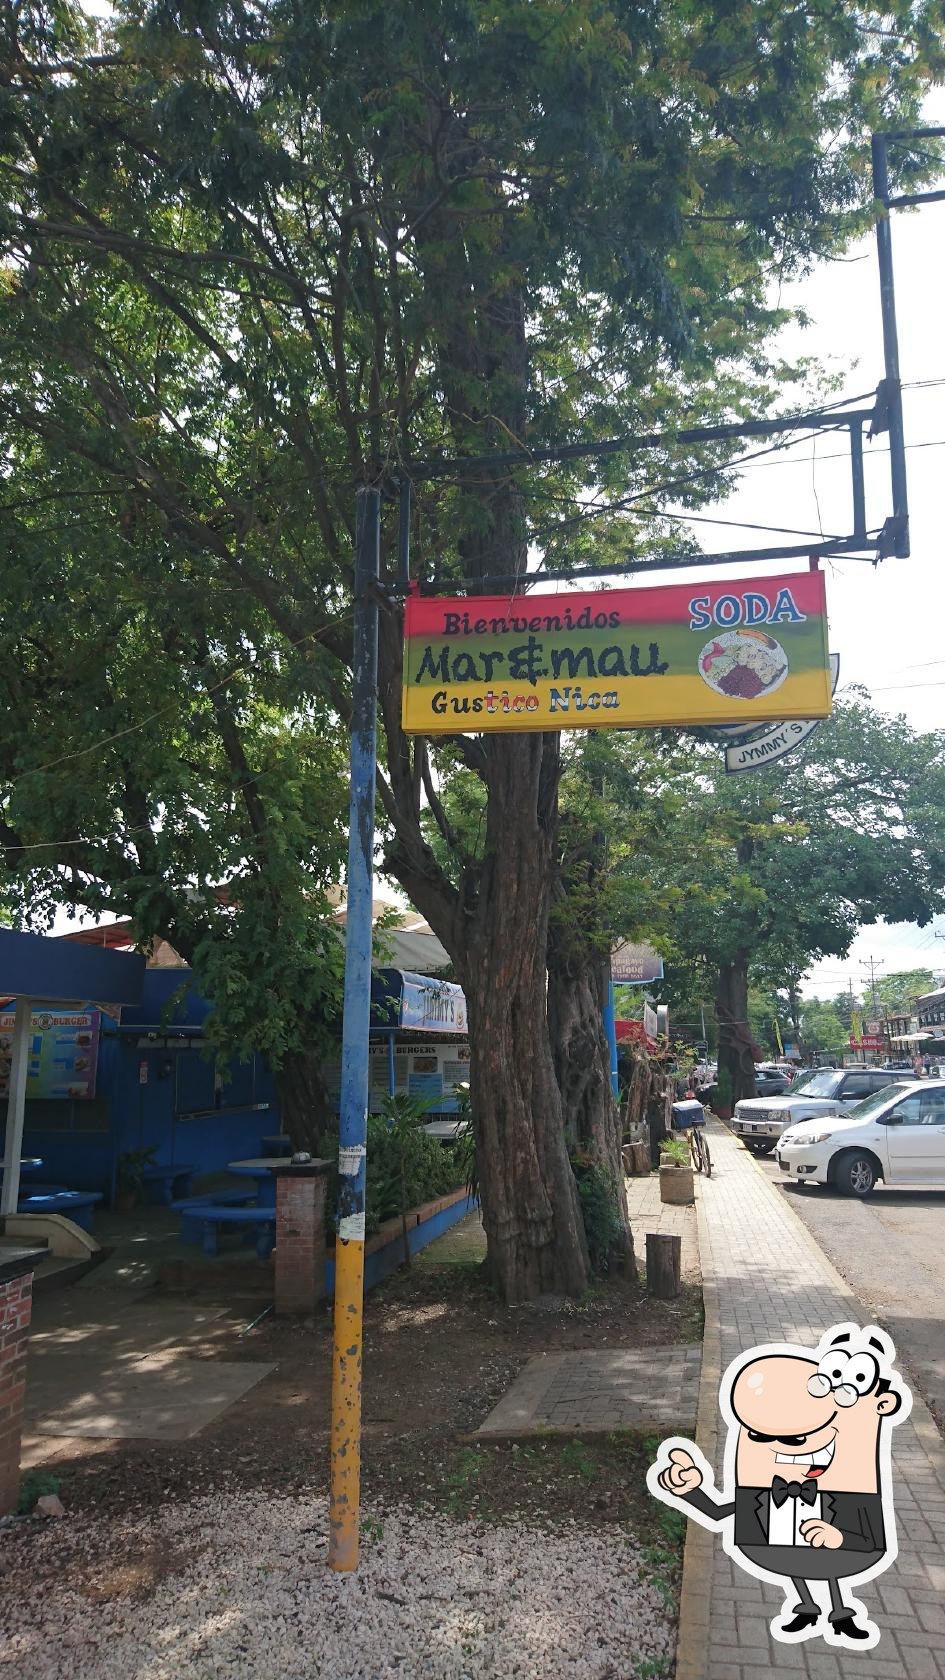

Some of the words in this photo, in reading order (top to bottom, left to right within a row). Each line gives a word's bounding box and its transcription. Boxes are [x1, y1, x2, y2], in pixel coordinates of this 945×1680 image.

[442, 606, 620, 635] Bienvenidos
[688, 587, 807, 631] SODA
[431, 690, 540, 714] Gustico
[549, 686, 620, 712] Nica
[738, 723, 803, 763] JYMMY'S
